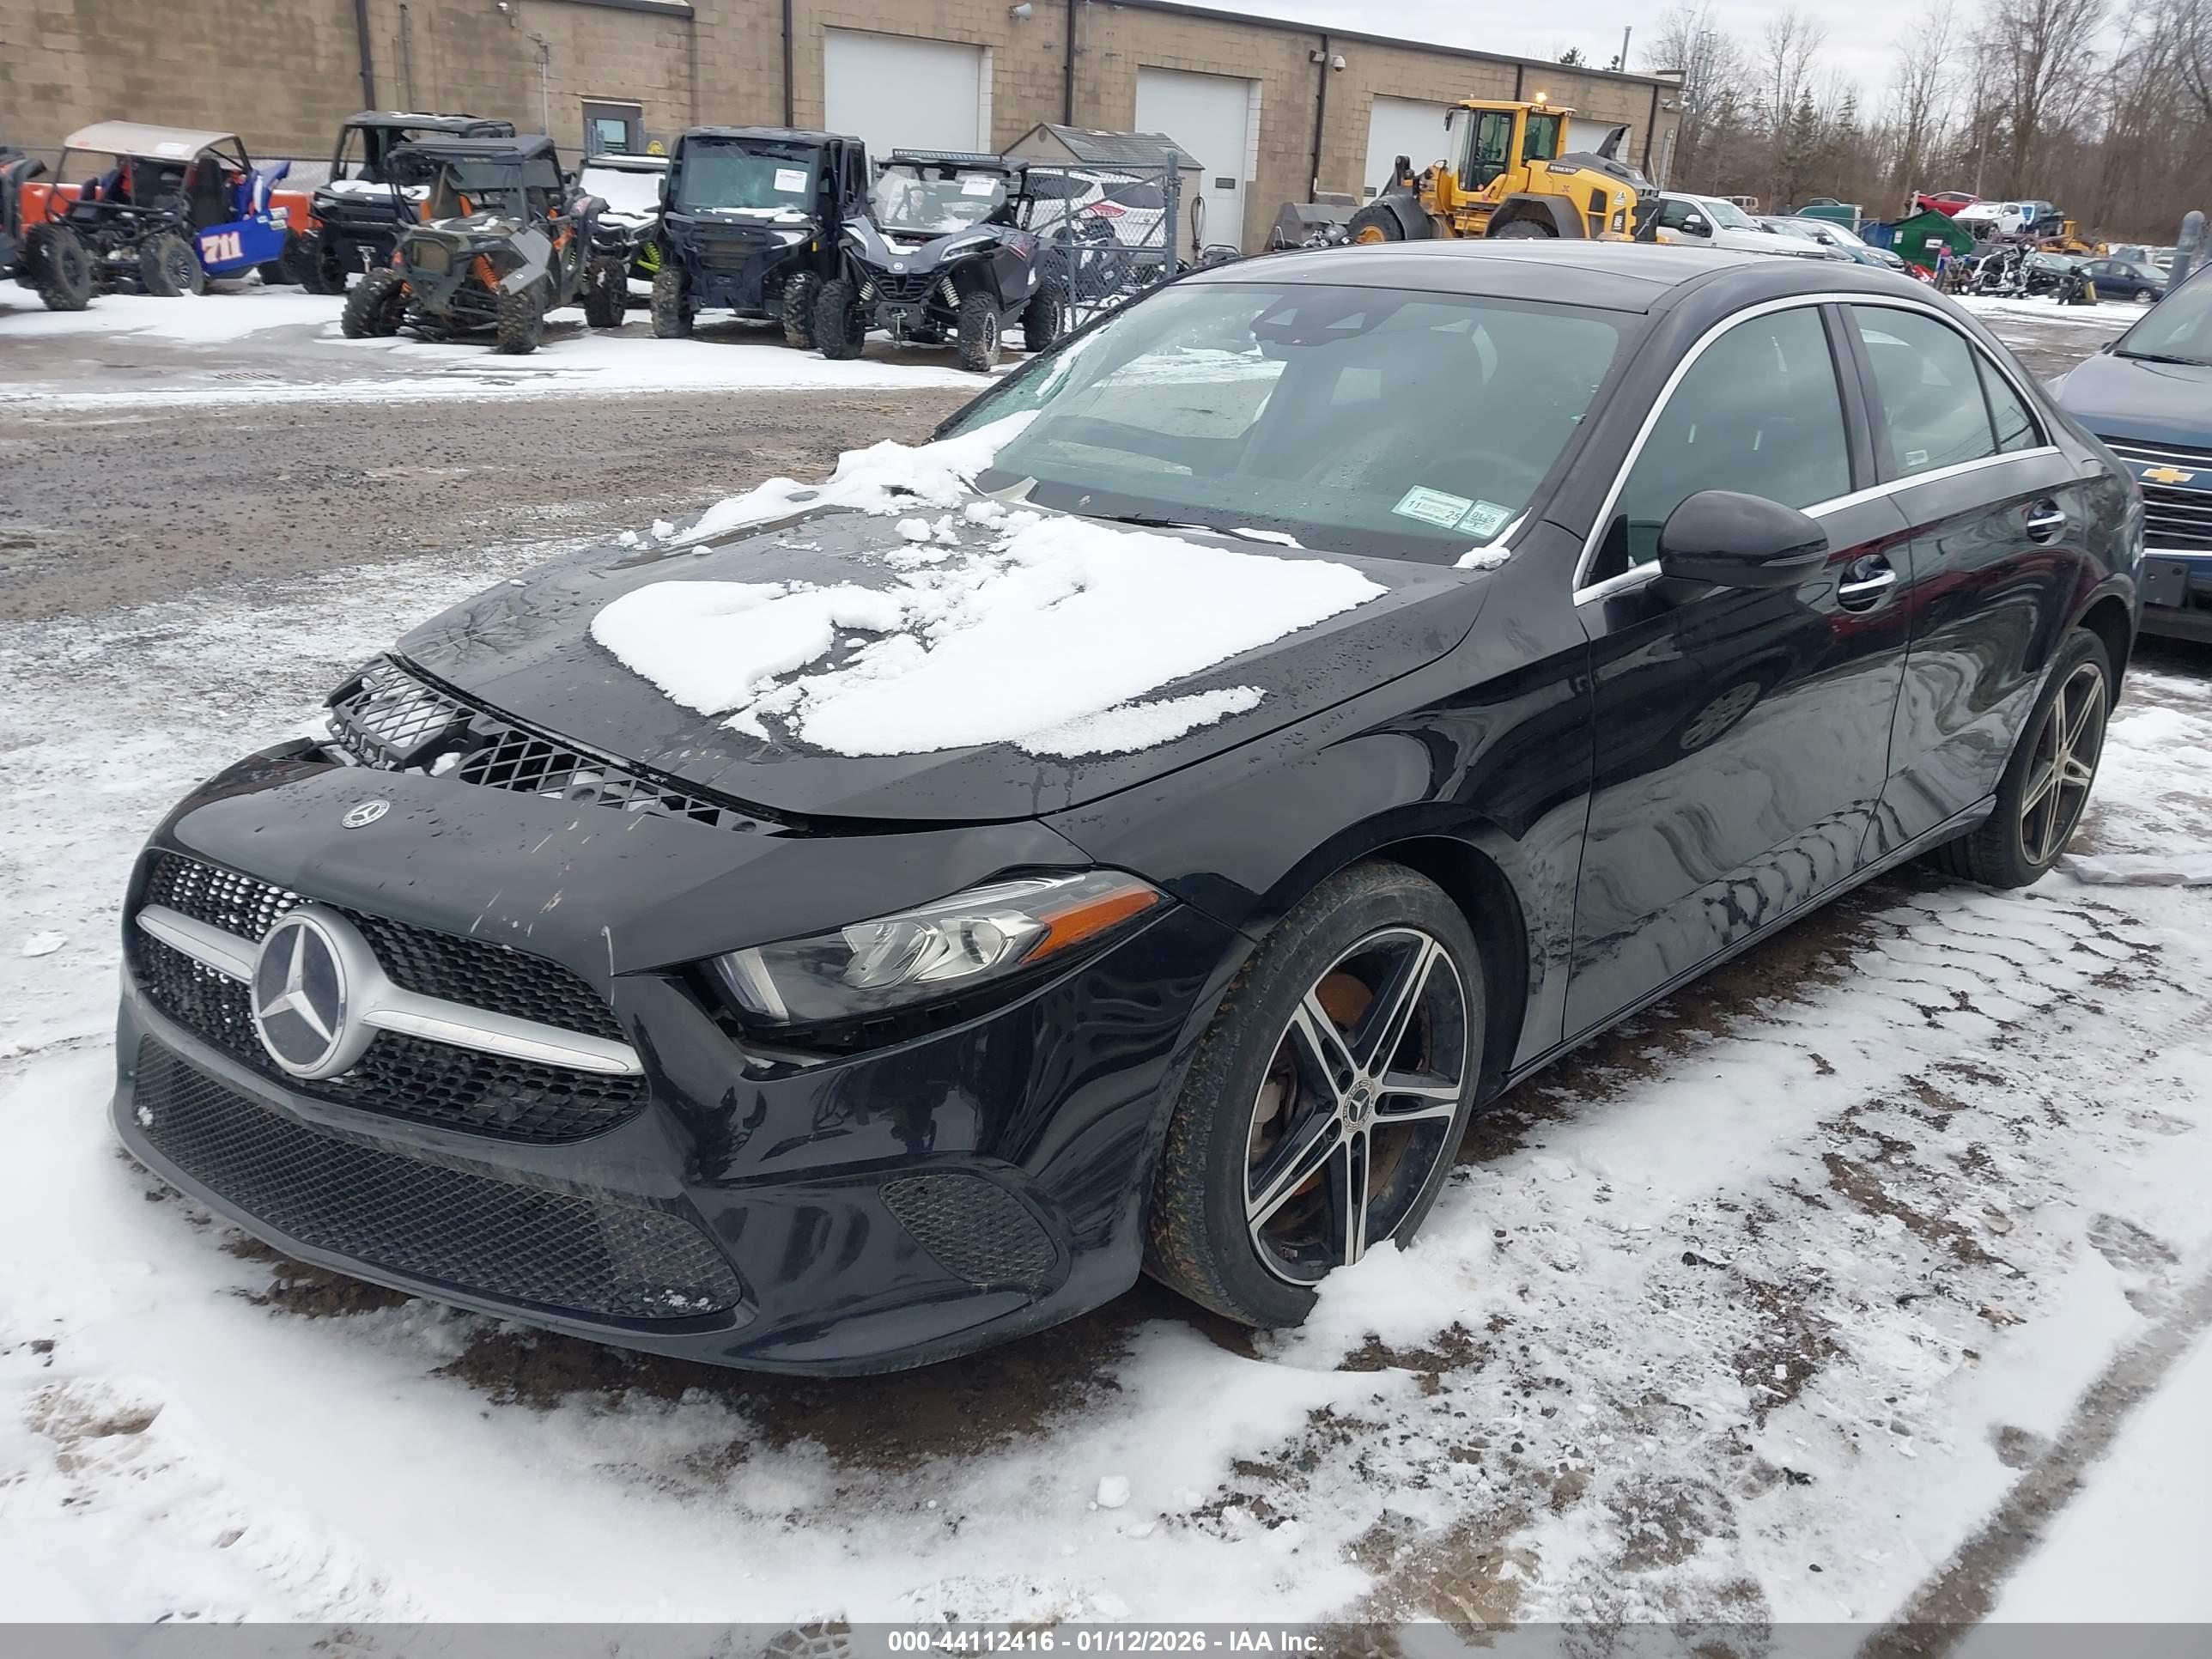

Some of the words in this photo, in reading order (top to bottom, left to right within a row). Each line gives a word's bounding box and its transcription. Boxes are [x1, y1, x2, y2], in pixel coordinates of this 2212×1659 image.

[200, 231, 244, 264] 711
[1407, 500, 1423, 511] 11
[1445, 510, 1462, 521] 25
